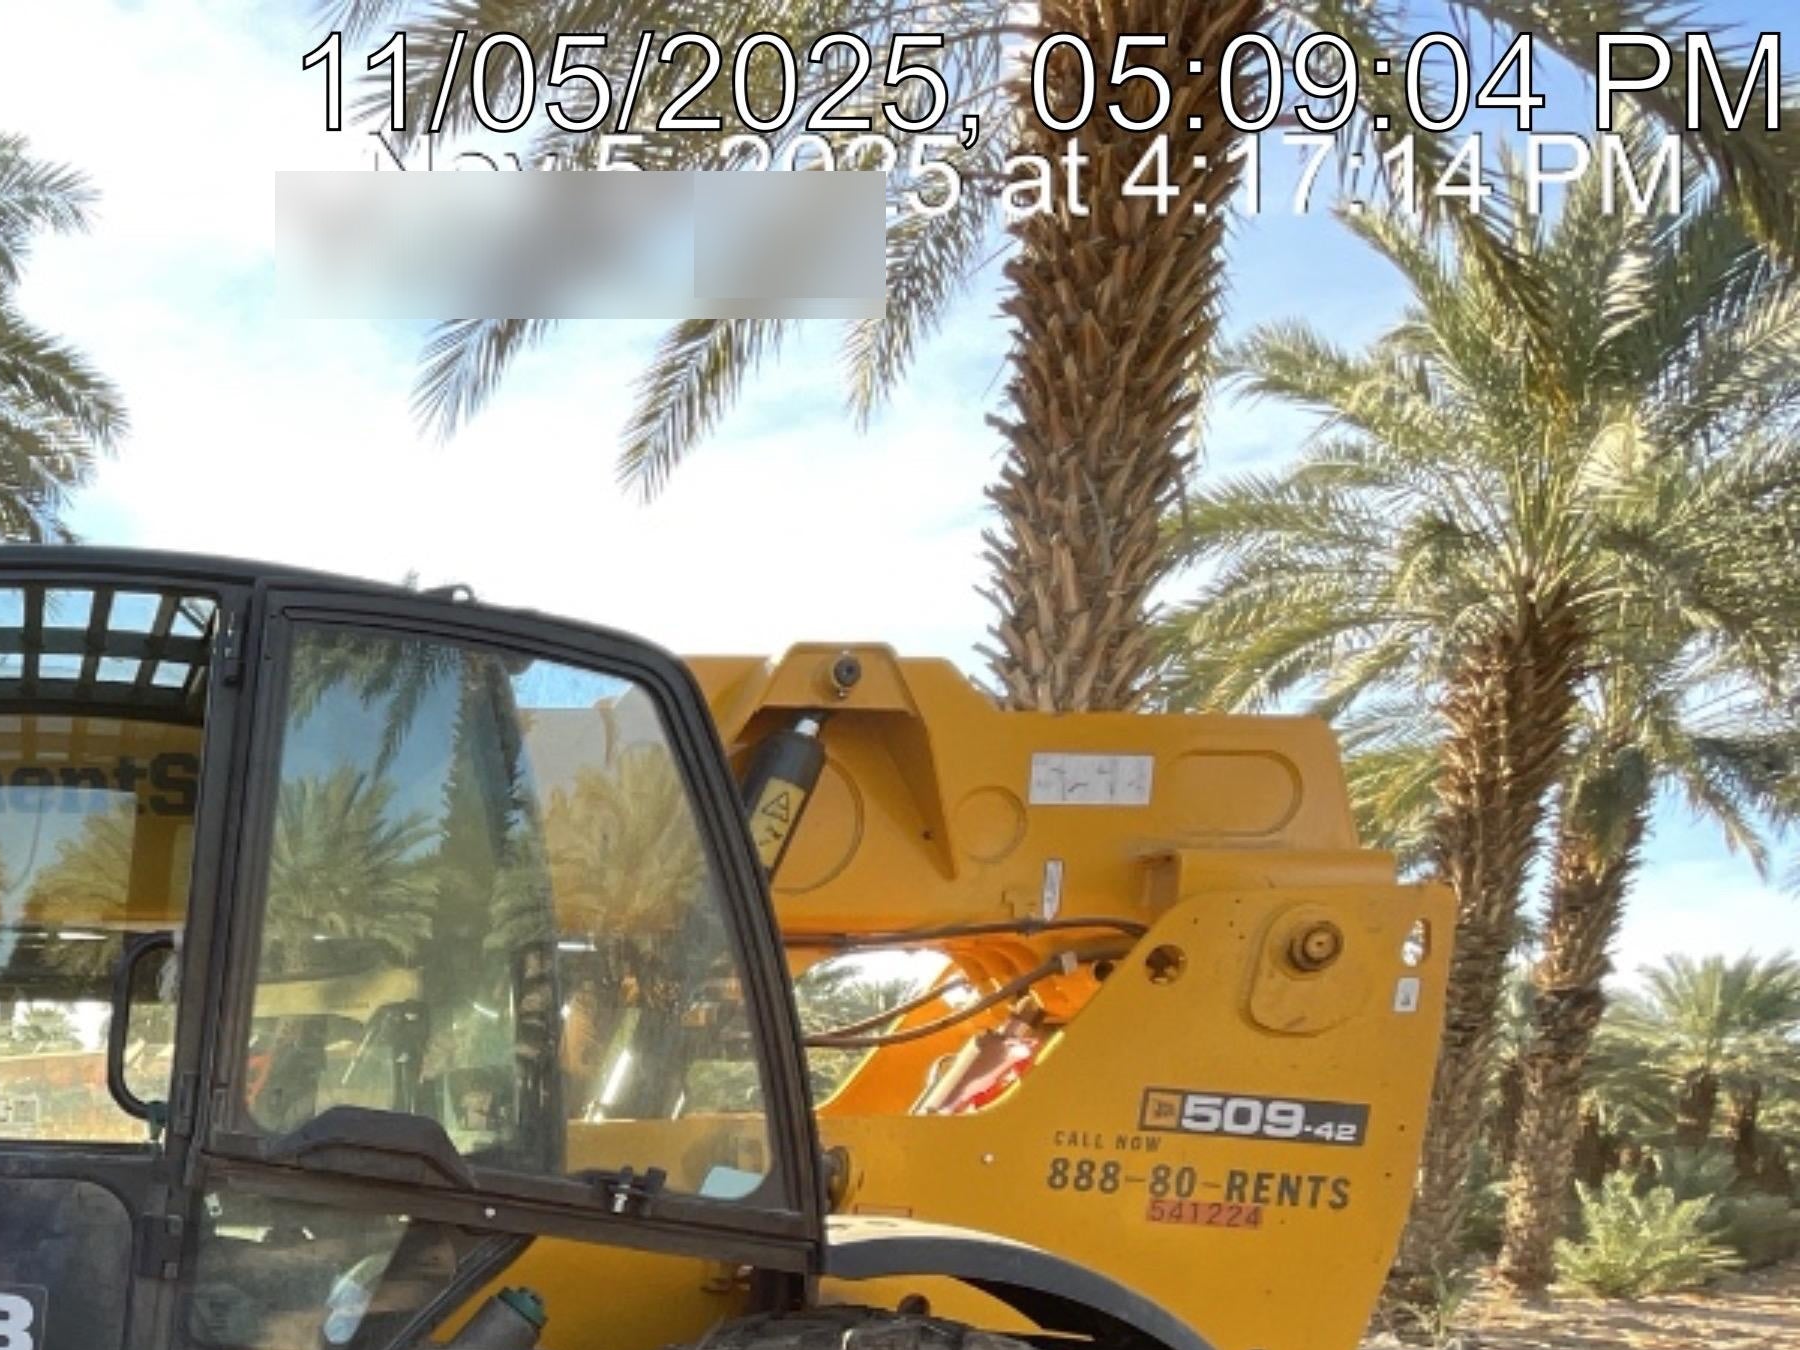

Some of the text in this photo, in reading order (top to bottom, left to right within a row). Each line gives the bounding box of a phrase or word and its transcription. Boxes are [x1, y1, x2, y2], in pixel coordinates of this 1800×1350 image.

[1053, 1130, 1162, 1152] CALL NOW
[1047, 1156, 1351, 1210] 888-80-RENTS
